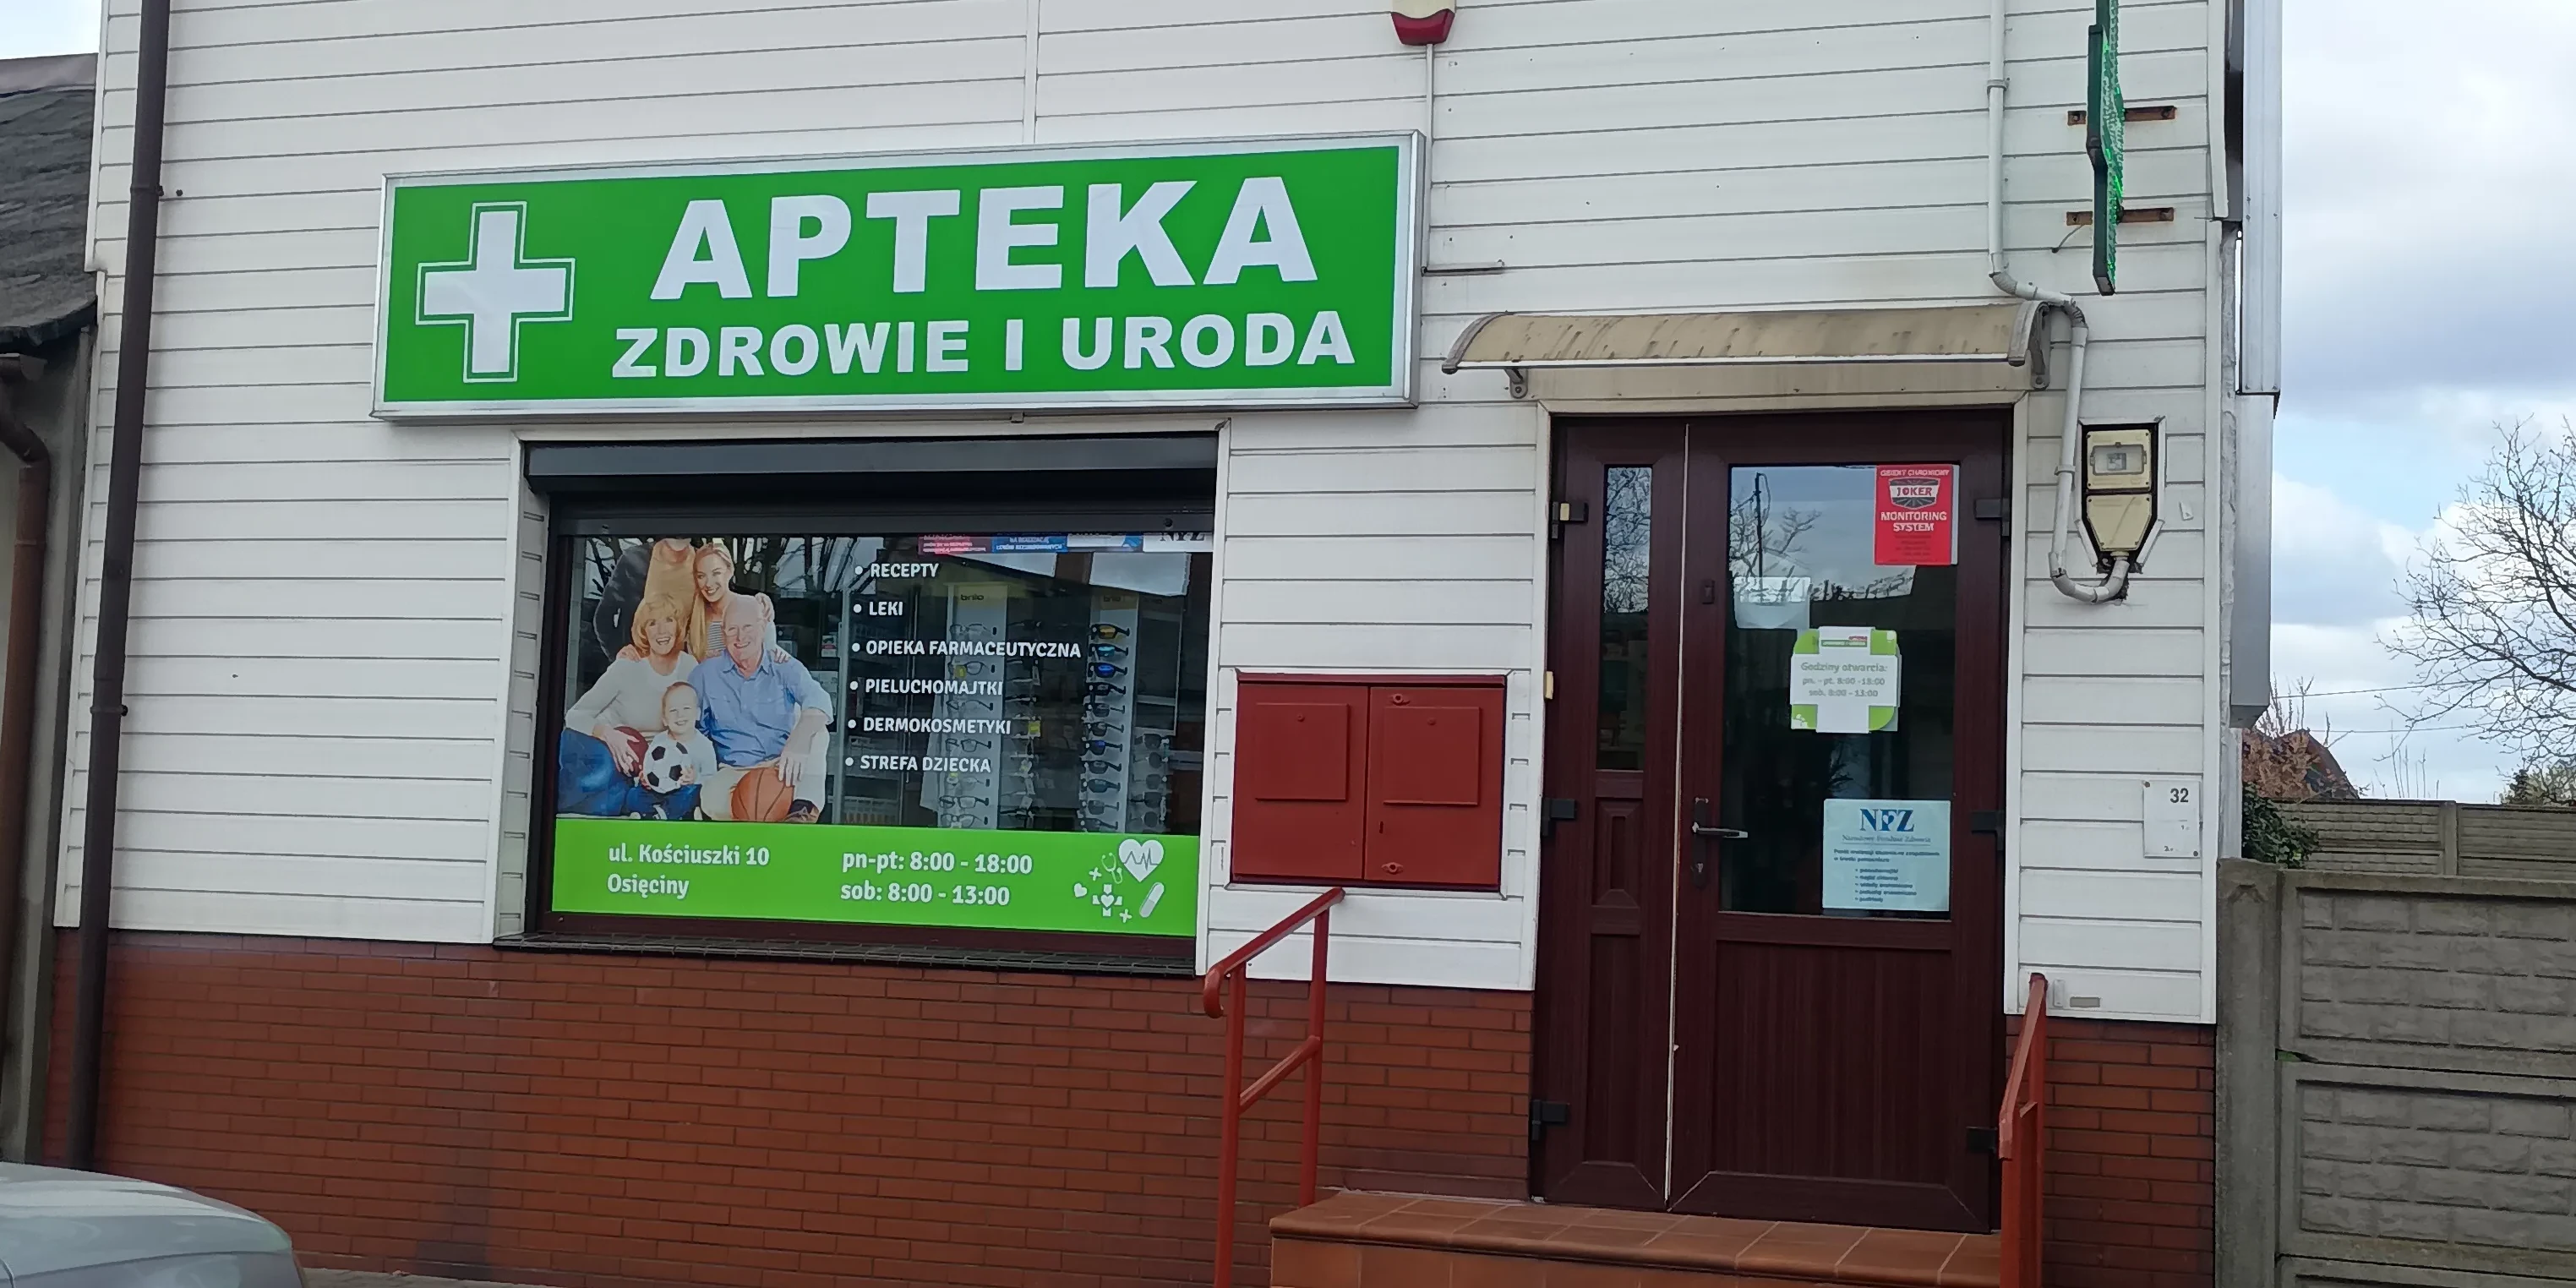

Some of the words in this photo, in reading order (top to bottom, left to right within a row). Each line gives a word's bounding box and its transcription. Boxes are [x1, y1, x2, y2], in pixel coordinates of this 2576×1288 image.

[650, 176, 1318, 300] APTEKA
[612, 320, 969, 378] ZDROWIE
[1005, 319, 1023, 371] I
[1062, 310, 1356, 370] URODA
[1897, 487, 1933, 497] JOKER
[1880, 511, 1947, 521] MONITORING
[1893, 522, 1935, 532] SYSTEM
[870, 563, 939, 578] RECEPTY
[869, 601, 903, 616] LEKI
[865, 640, 925, 655] OPIEKA
[929, 641, 1081, 658] FARMACEUTYCZNA
[1801, 662, 1840, 674] Godziny
[865, 679, 1003, 696] PIELUCHOMAJTKI
[863, 717, 1012, 734] DERMOKOSMETYKI
[860, 755, 918, 772] STREFA
[922, 756, 991, 773] DZIECKA
[2169, 788, 2189, 803] 32
[1860, 808, 1915, 832] NFZ
[609, 842, 633, 862] ul.
[639, 843, 740, 865] Kościuszki
[745, 847, 770, 866] 10
[842, 851, 904, 874] pn-pt:
[909, 851, 955, 871] 8:00
[974, 854, 1033, 874] 18:00
[607, 873, 690, 900] Osięciny
[840, 880, 882, 901] sob:
[887, 882, 933, 903] 8:00
[952, 885, 1010, 906] 13:00
